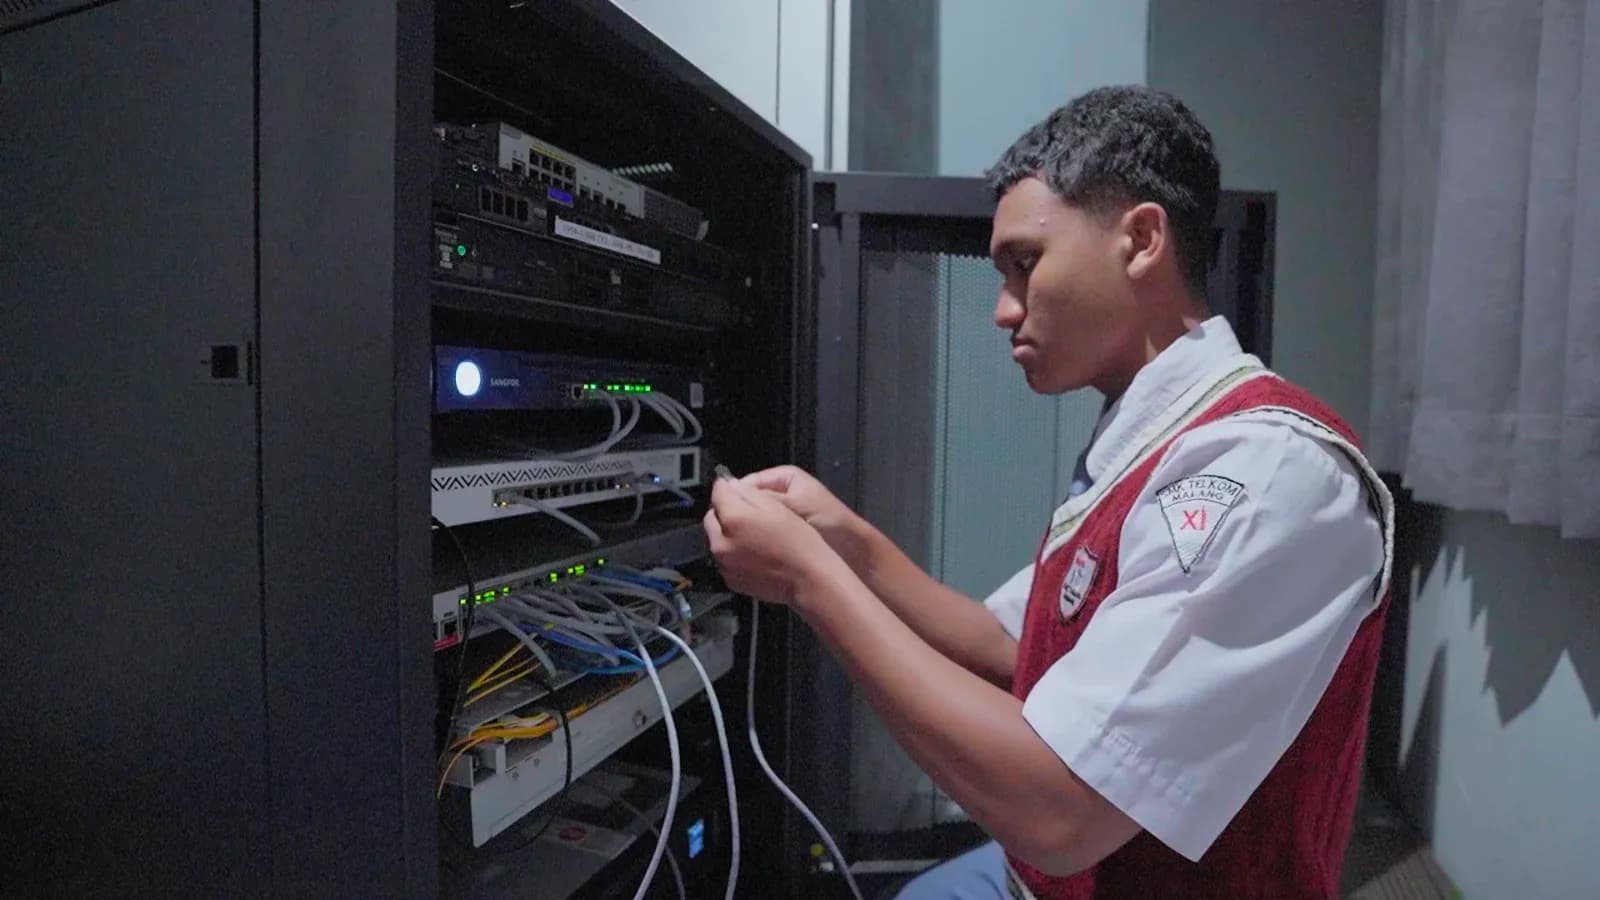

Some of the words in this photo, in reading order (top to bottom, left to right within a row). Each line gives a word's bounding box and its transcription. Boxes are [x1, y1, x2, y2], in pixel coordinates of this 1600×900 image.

[1171, 490, 1224, 501] MALANG
[1189, 479, 1238, 496] TELKOM
[1179, 507, 1207, 531] XI
